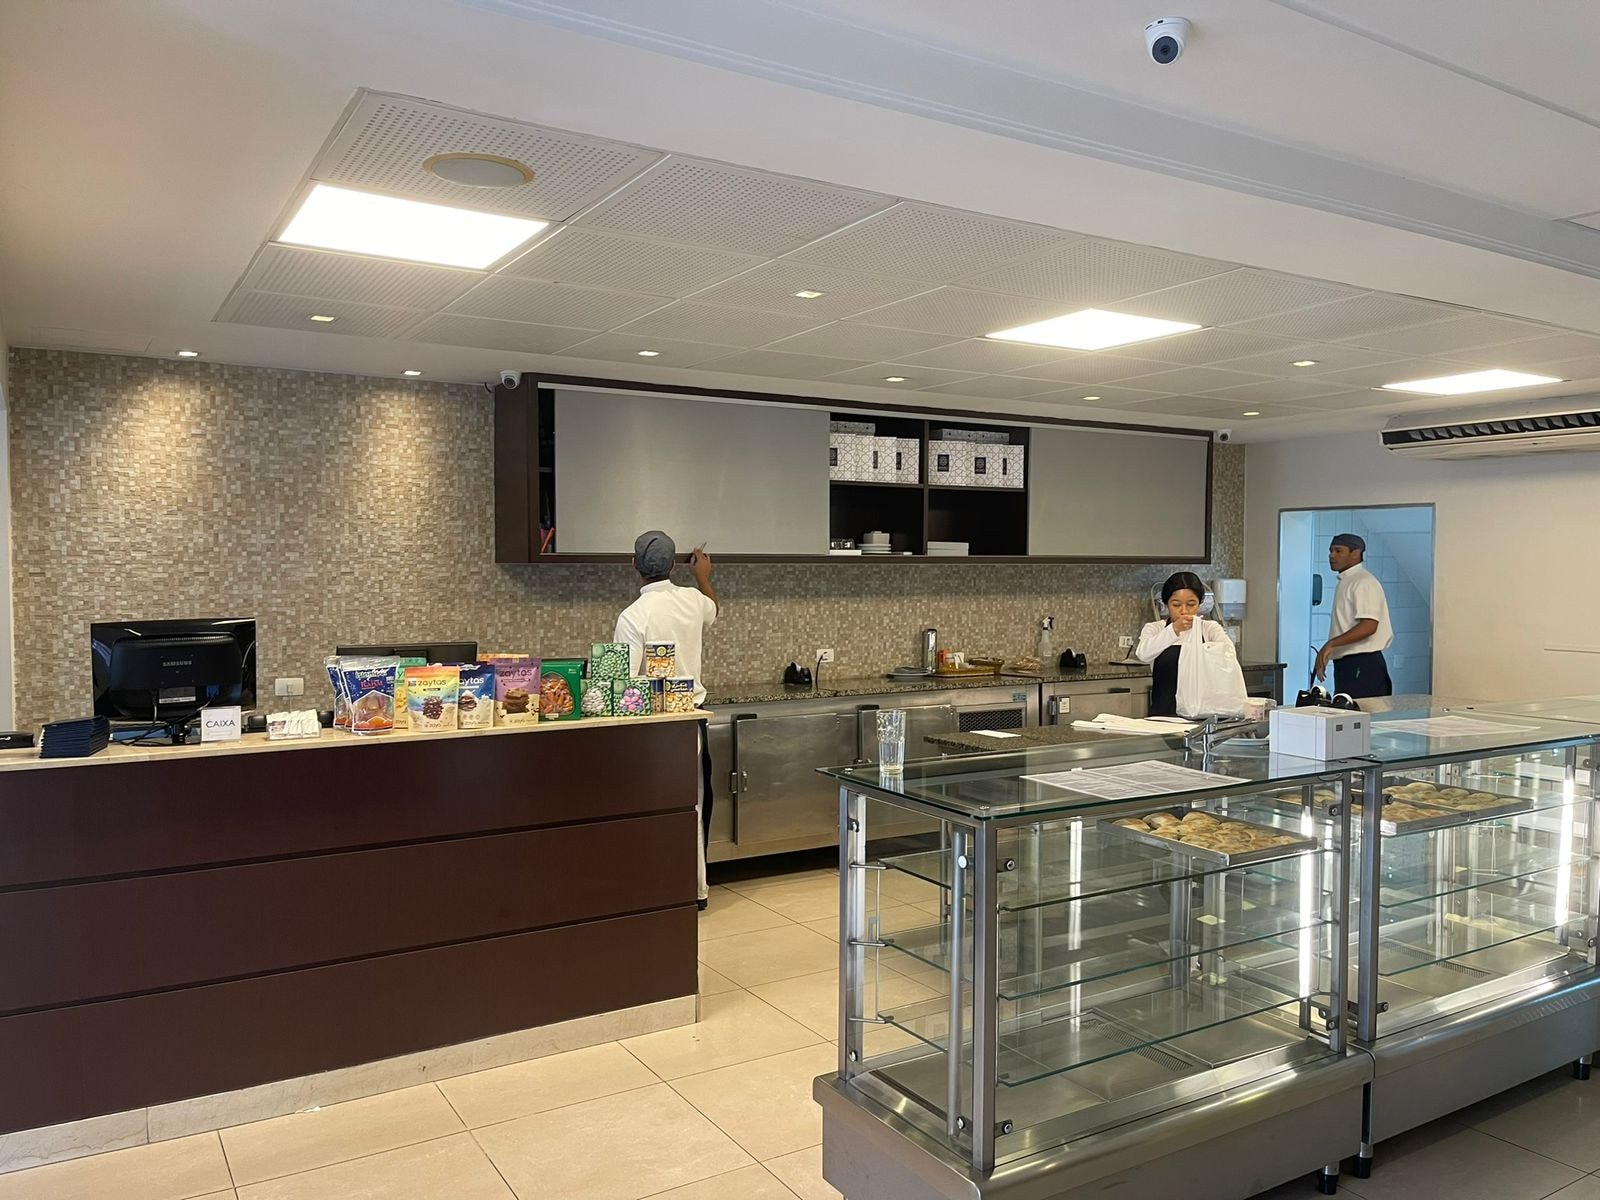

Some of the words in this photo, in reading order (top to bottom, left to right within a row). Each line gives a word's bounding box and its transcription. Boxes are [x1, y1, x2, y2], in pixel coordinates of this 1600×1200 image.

[499, 668, 532, 679] zaytas
[418, 679, 447, 687] zaytas
[459, 676, 485, 686] aytas
[206, 719, 236, 729] CAIXA
